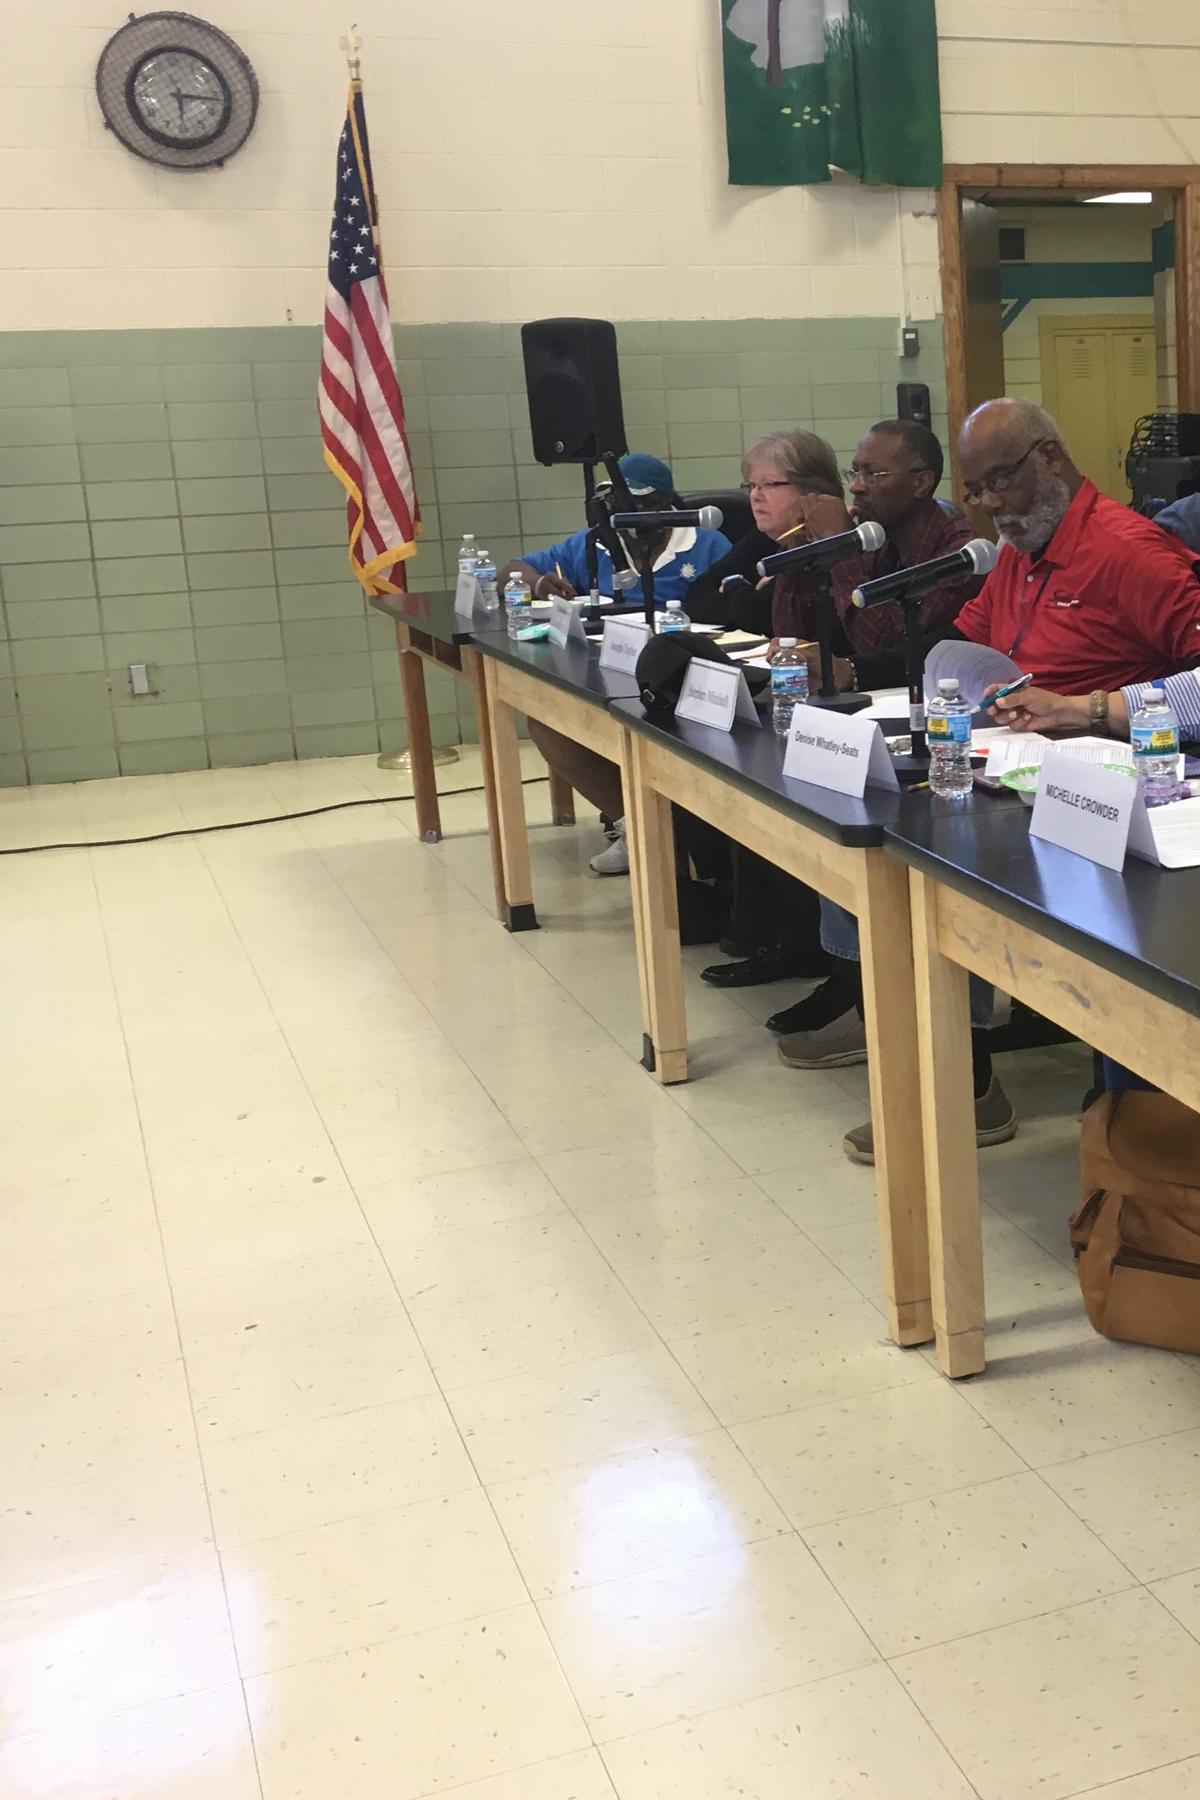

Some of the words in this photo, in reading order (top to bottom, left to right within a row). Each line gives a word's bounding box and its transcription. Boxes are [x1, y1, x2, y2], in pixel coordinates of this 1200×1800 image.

[795, 730, 815, 746] Denise
[816, 735, 860, 758] Whatley-Seats
[1045, 783, 1081, 808] MICHELLE
[1080, 796, 1119, 822] CROWDER
